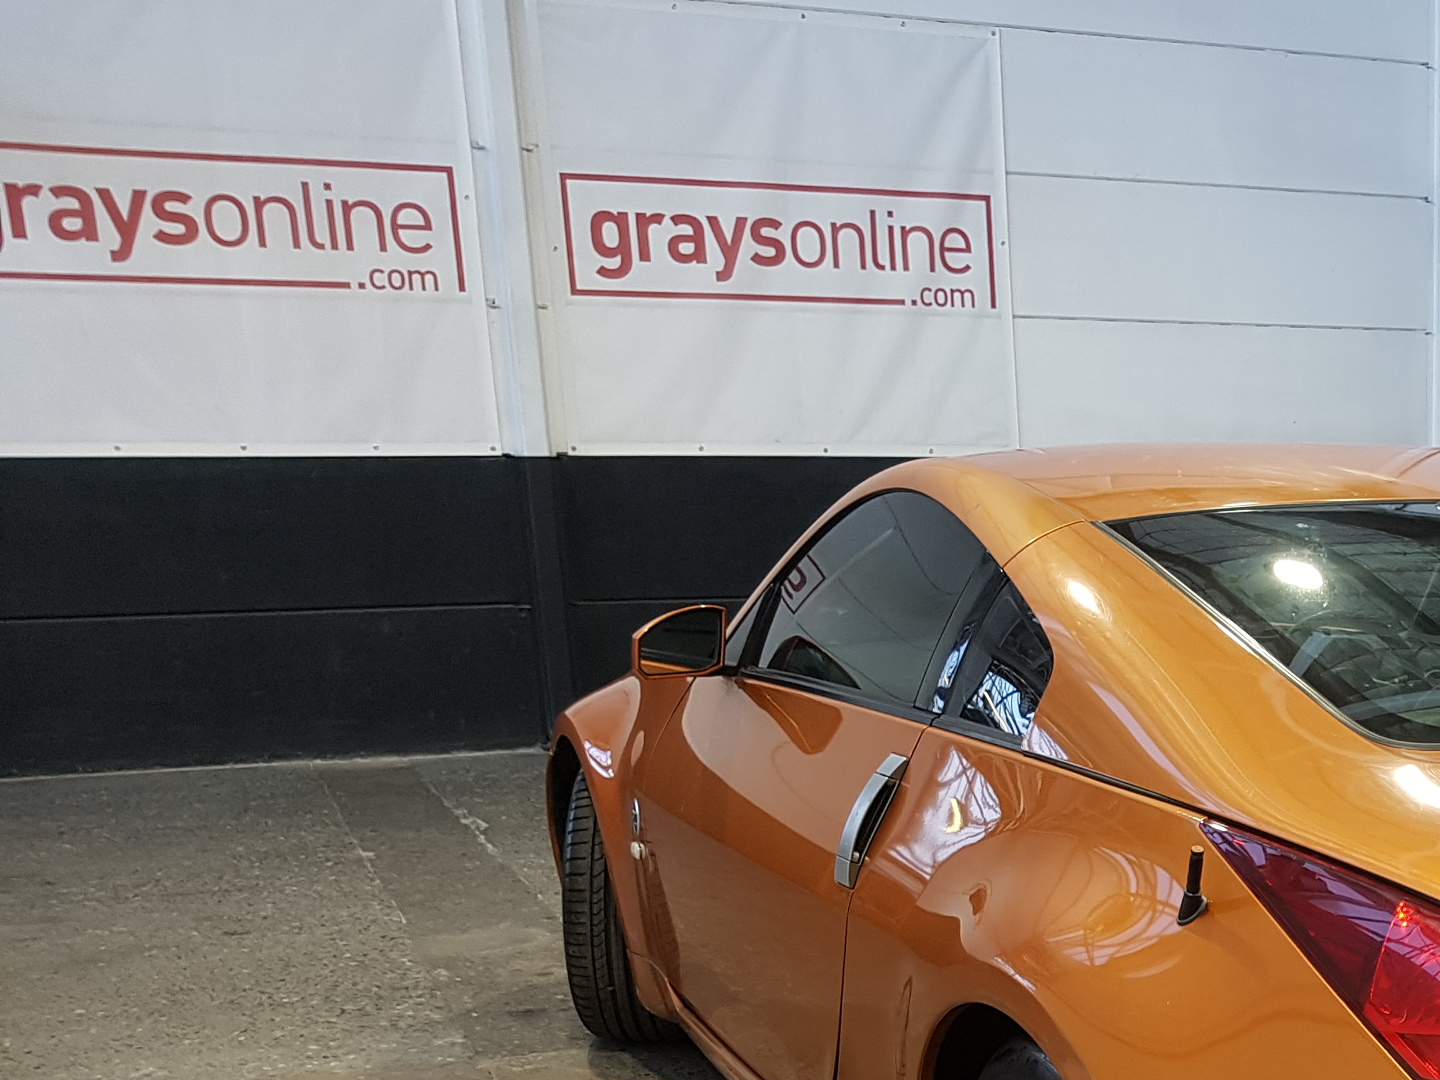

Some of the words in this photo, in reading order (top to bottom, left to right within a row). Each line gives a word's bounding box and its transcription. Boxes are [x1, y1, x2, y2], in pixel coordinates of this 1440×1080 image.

[0, 181, 434, 263] raysonline
[590, 209, 973, 283] graysonline
[357, 267, 440, 292] .com
[910, 284, 976, 309] .com
